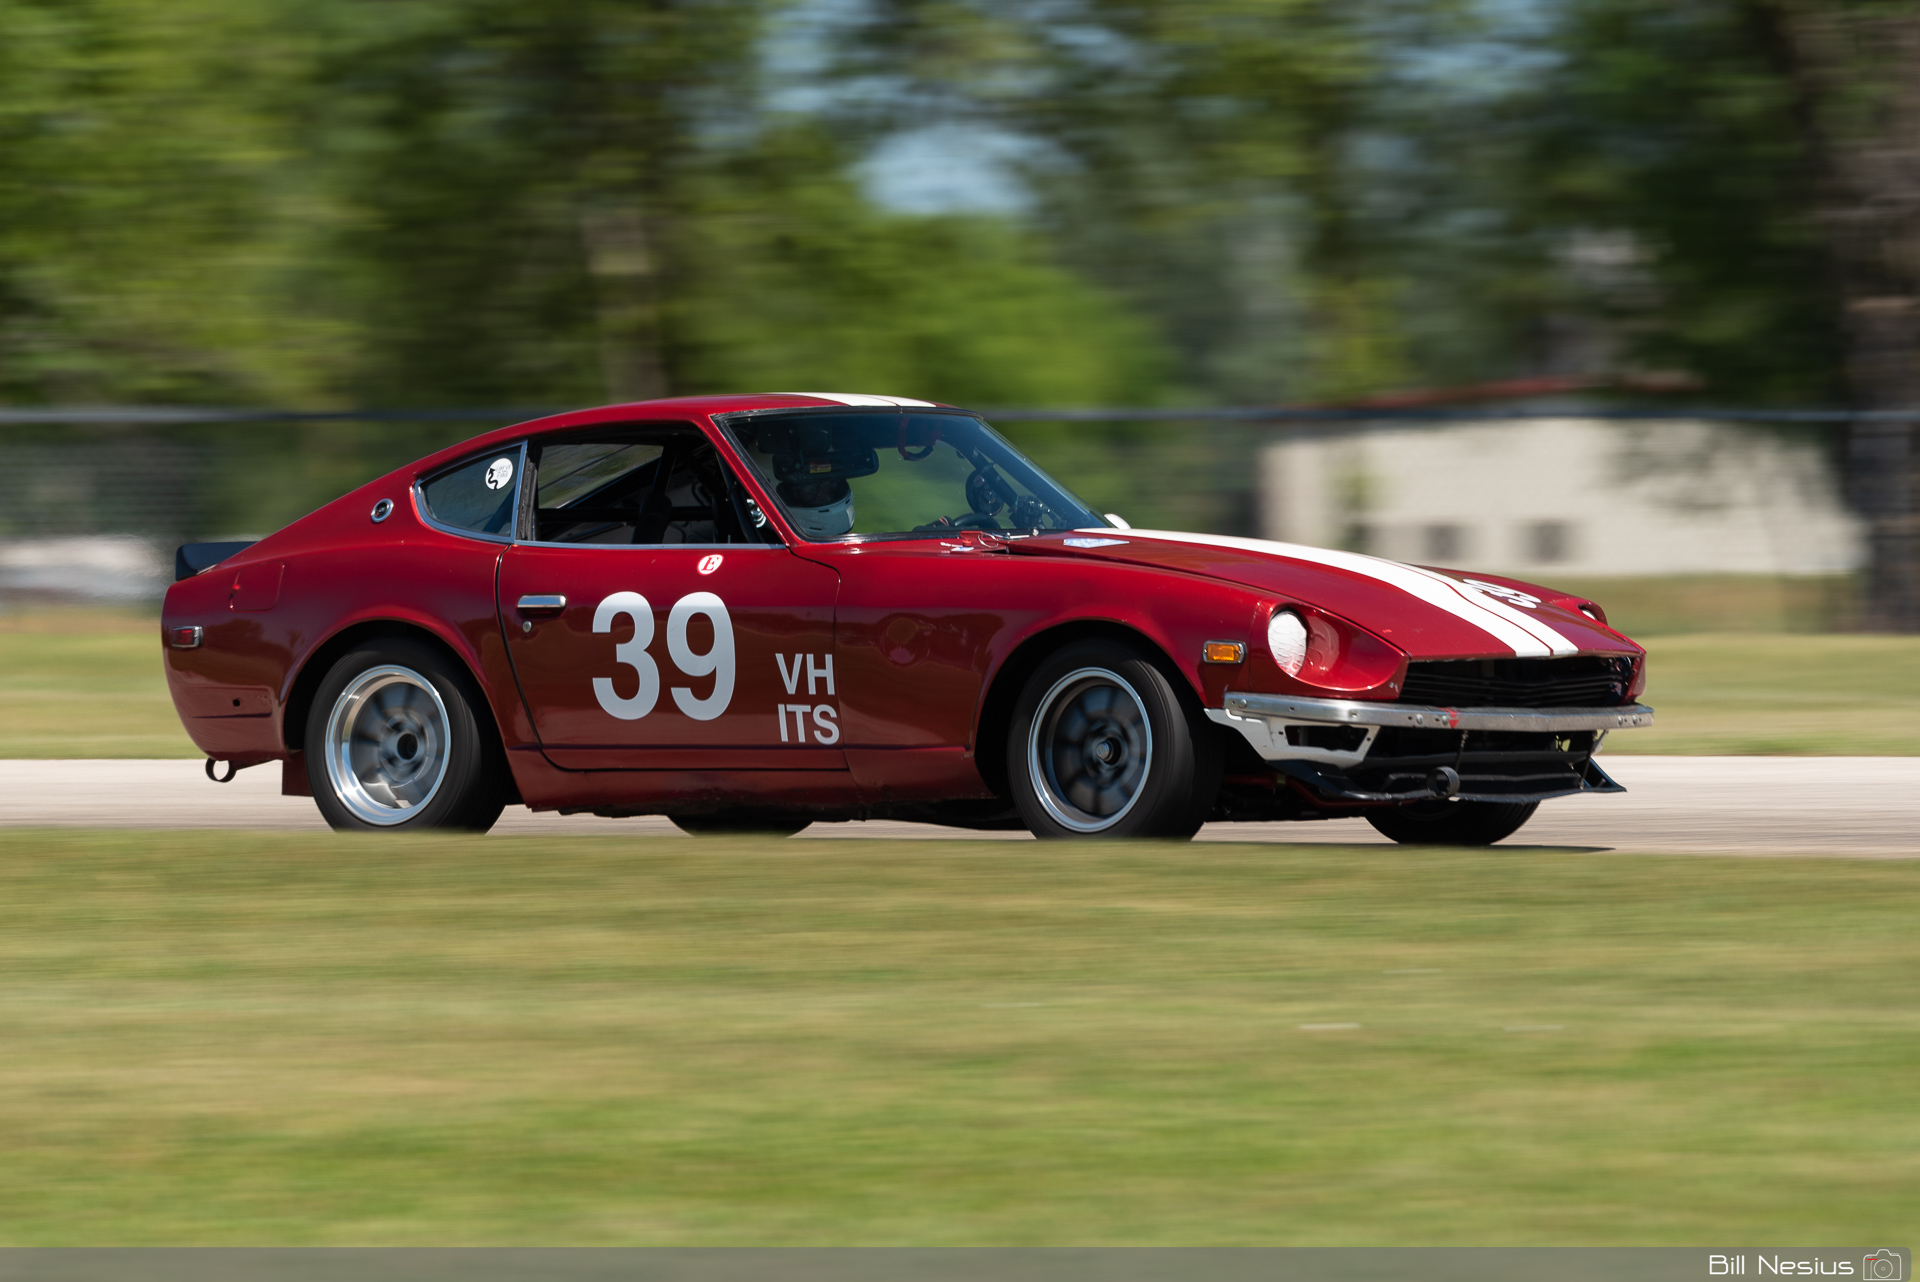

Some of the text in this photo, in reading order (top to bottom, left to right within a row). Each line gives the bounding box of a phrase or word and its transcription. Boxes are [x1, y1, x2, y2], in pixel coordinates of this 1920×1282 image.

[701, 557, 720, 571] E
[592, 591, 736, 721] 39
[775, 653, 836, 695] VH
[777, 703, 840, 745] ITS
